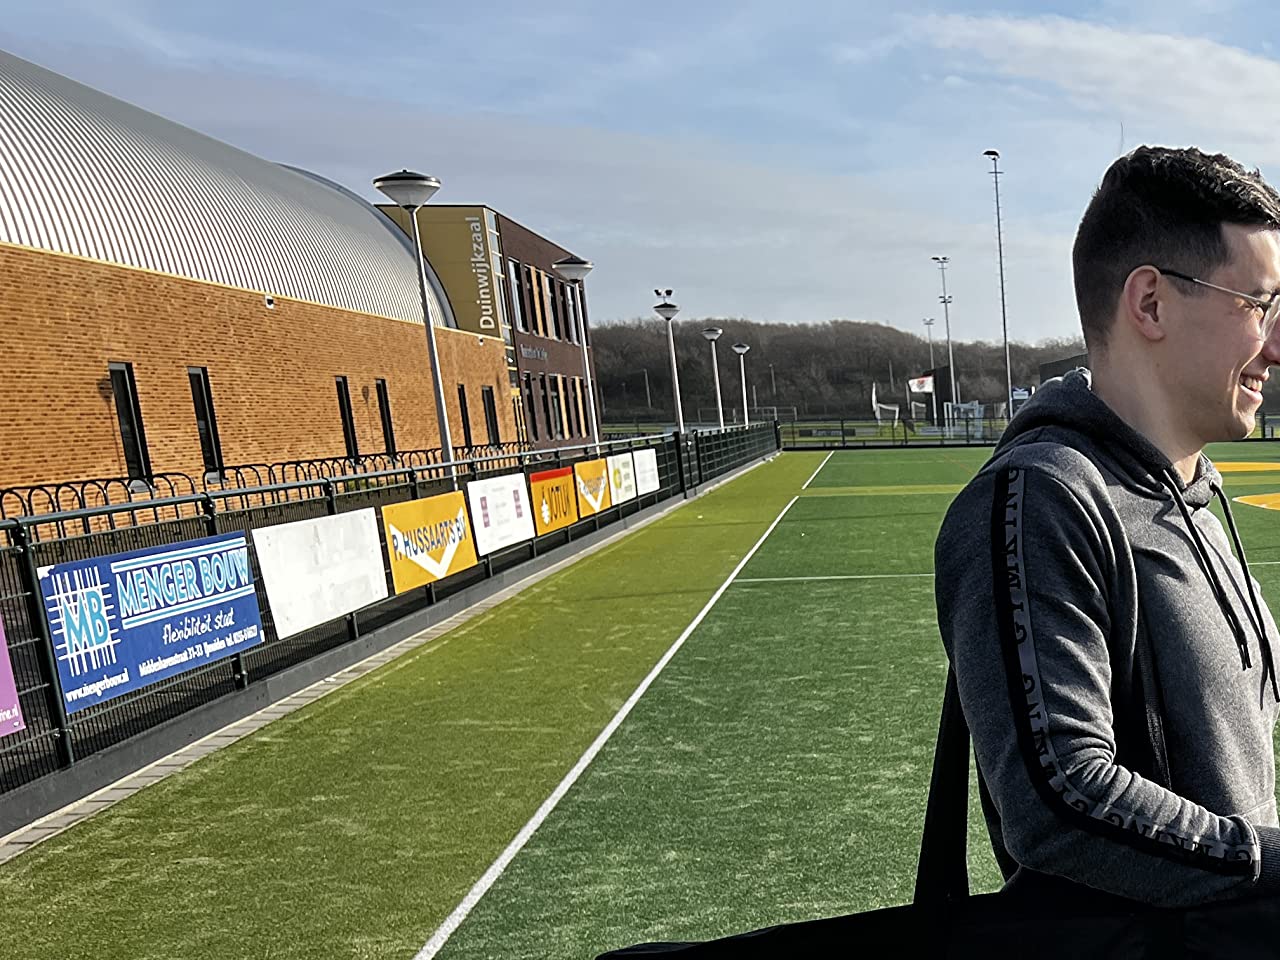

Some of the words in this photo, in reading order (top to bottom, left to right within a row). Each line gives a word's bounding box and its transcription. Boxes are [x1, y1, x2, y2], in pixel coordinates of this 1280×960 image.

[465, 217, 495, 329] Duinwijkzaal
[404, 519, 456, 557] HUSSAARTS
[455, 516, 467, 542] BV
[116, 557, 202, 618] MENGER
[199, 546, 249, 596] BOUW
[62, 590, 110, 654] MB
